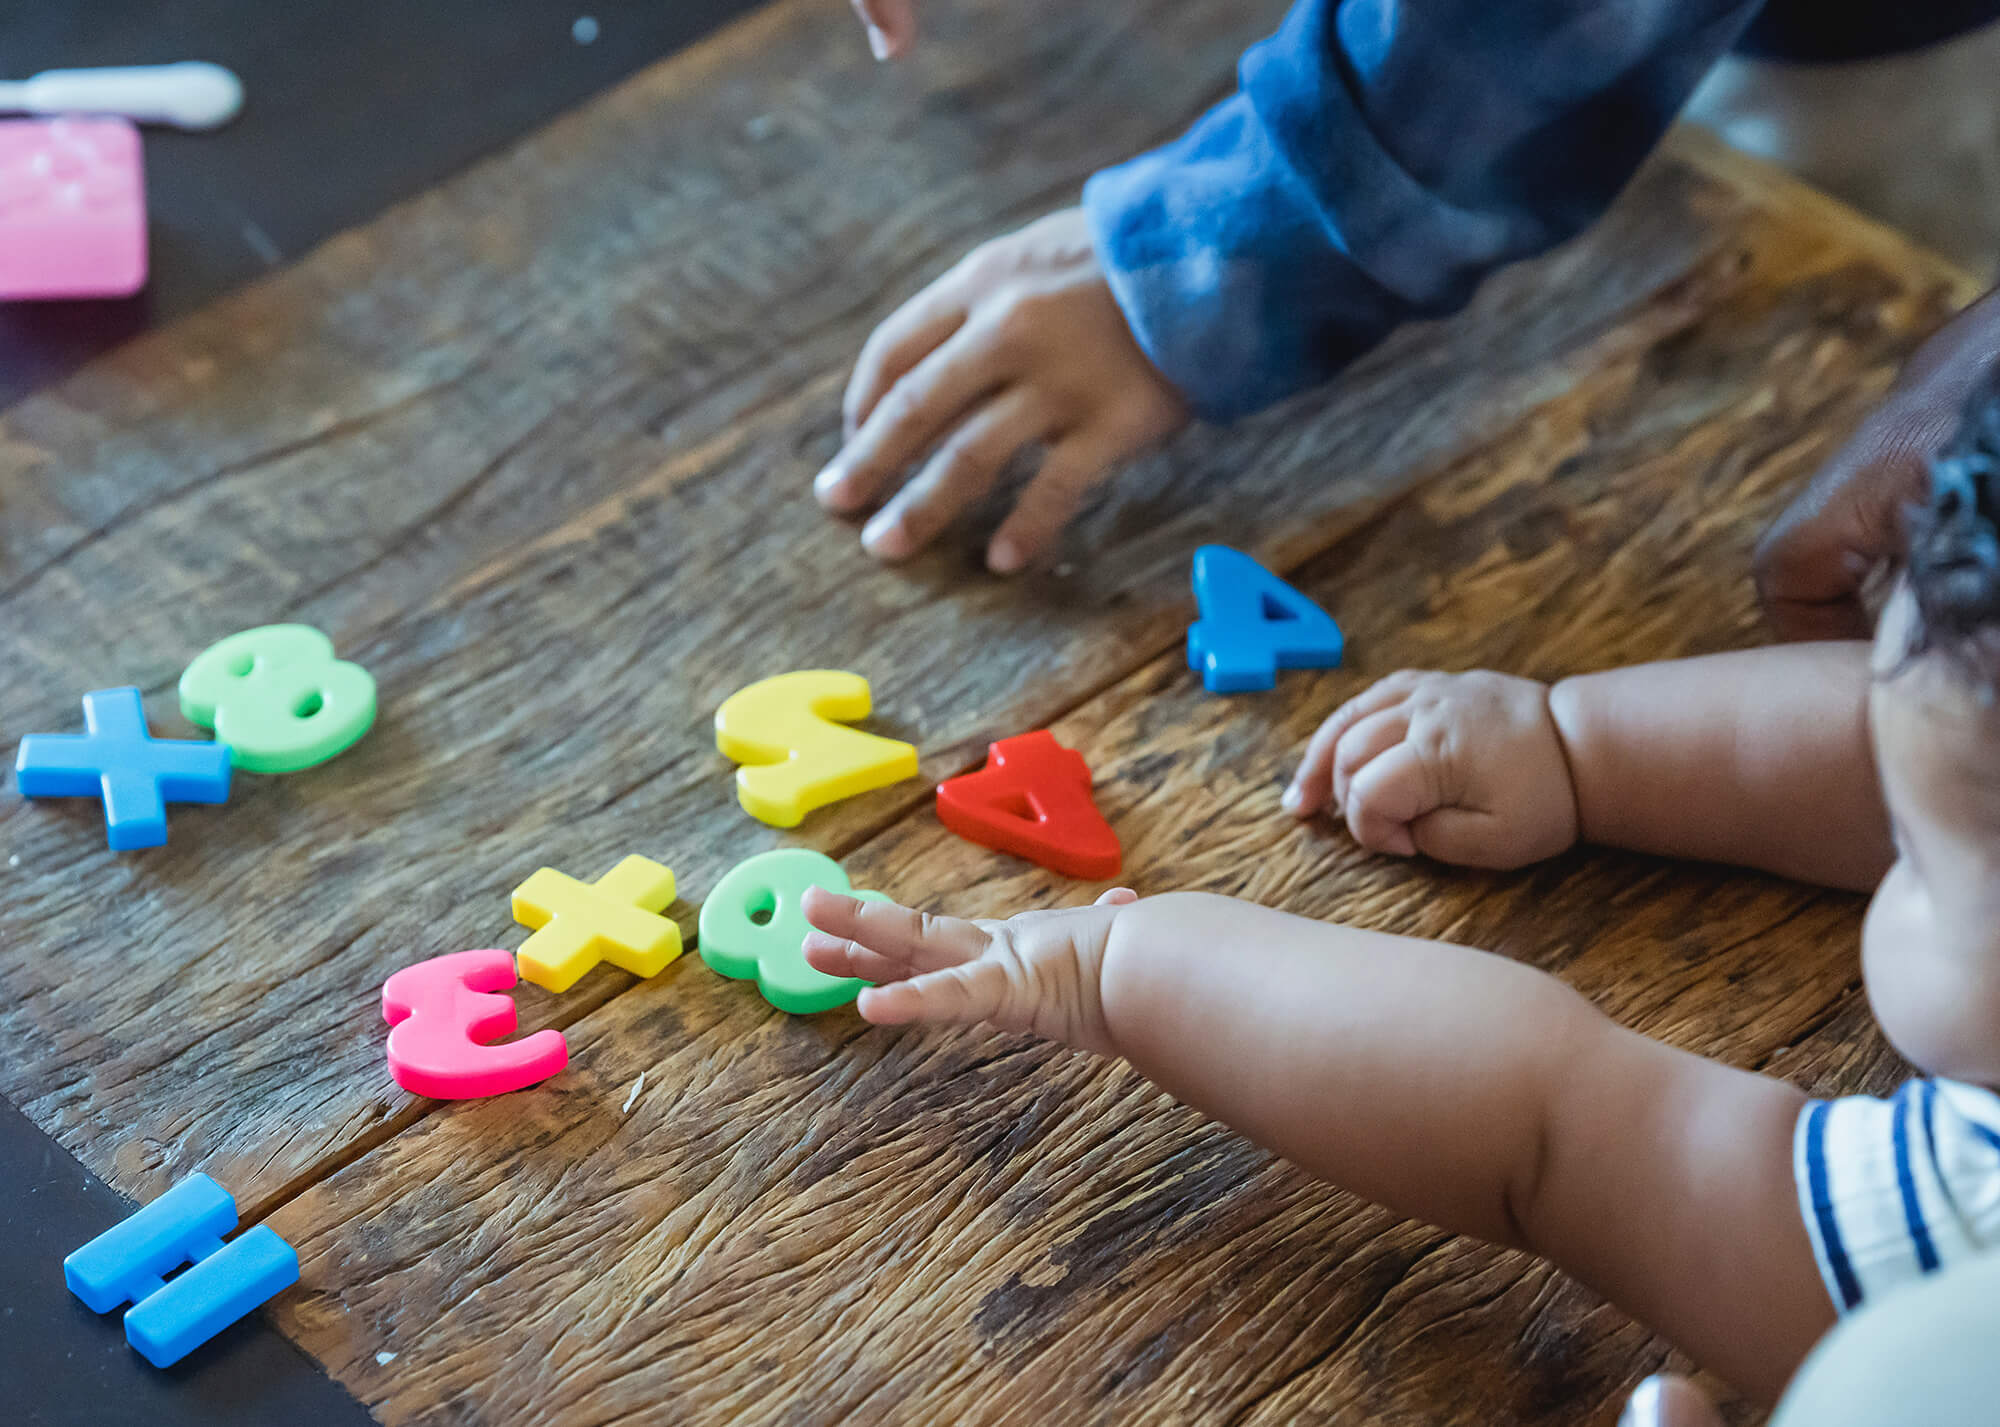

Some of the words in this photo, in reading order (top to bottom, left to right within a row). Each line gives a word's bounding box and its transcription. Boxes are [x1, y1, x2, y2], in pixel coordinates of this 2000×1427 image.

[1187, 545, 1344, 693] 4
[179, 624, 377, 774] 8
[936, 729, 1121, 880] 4
